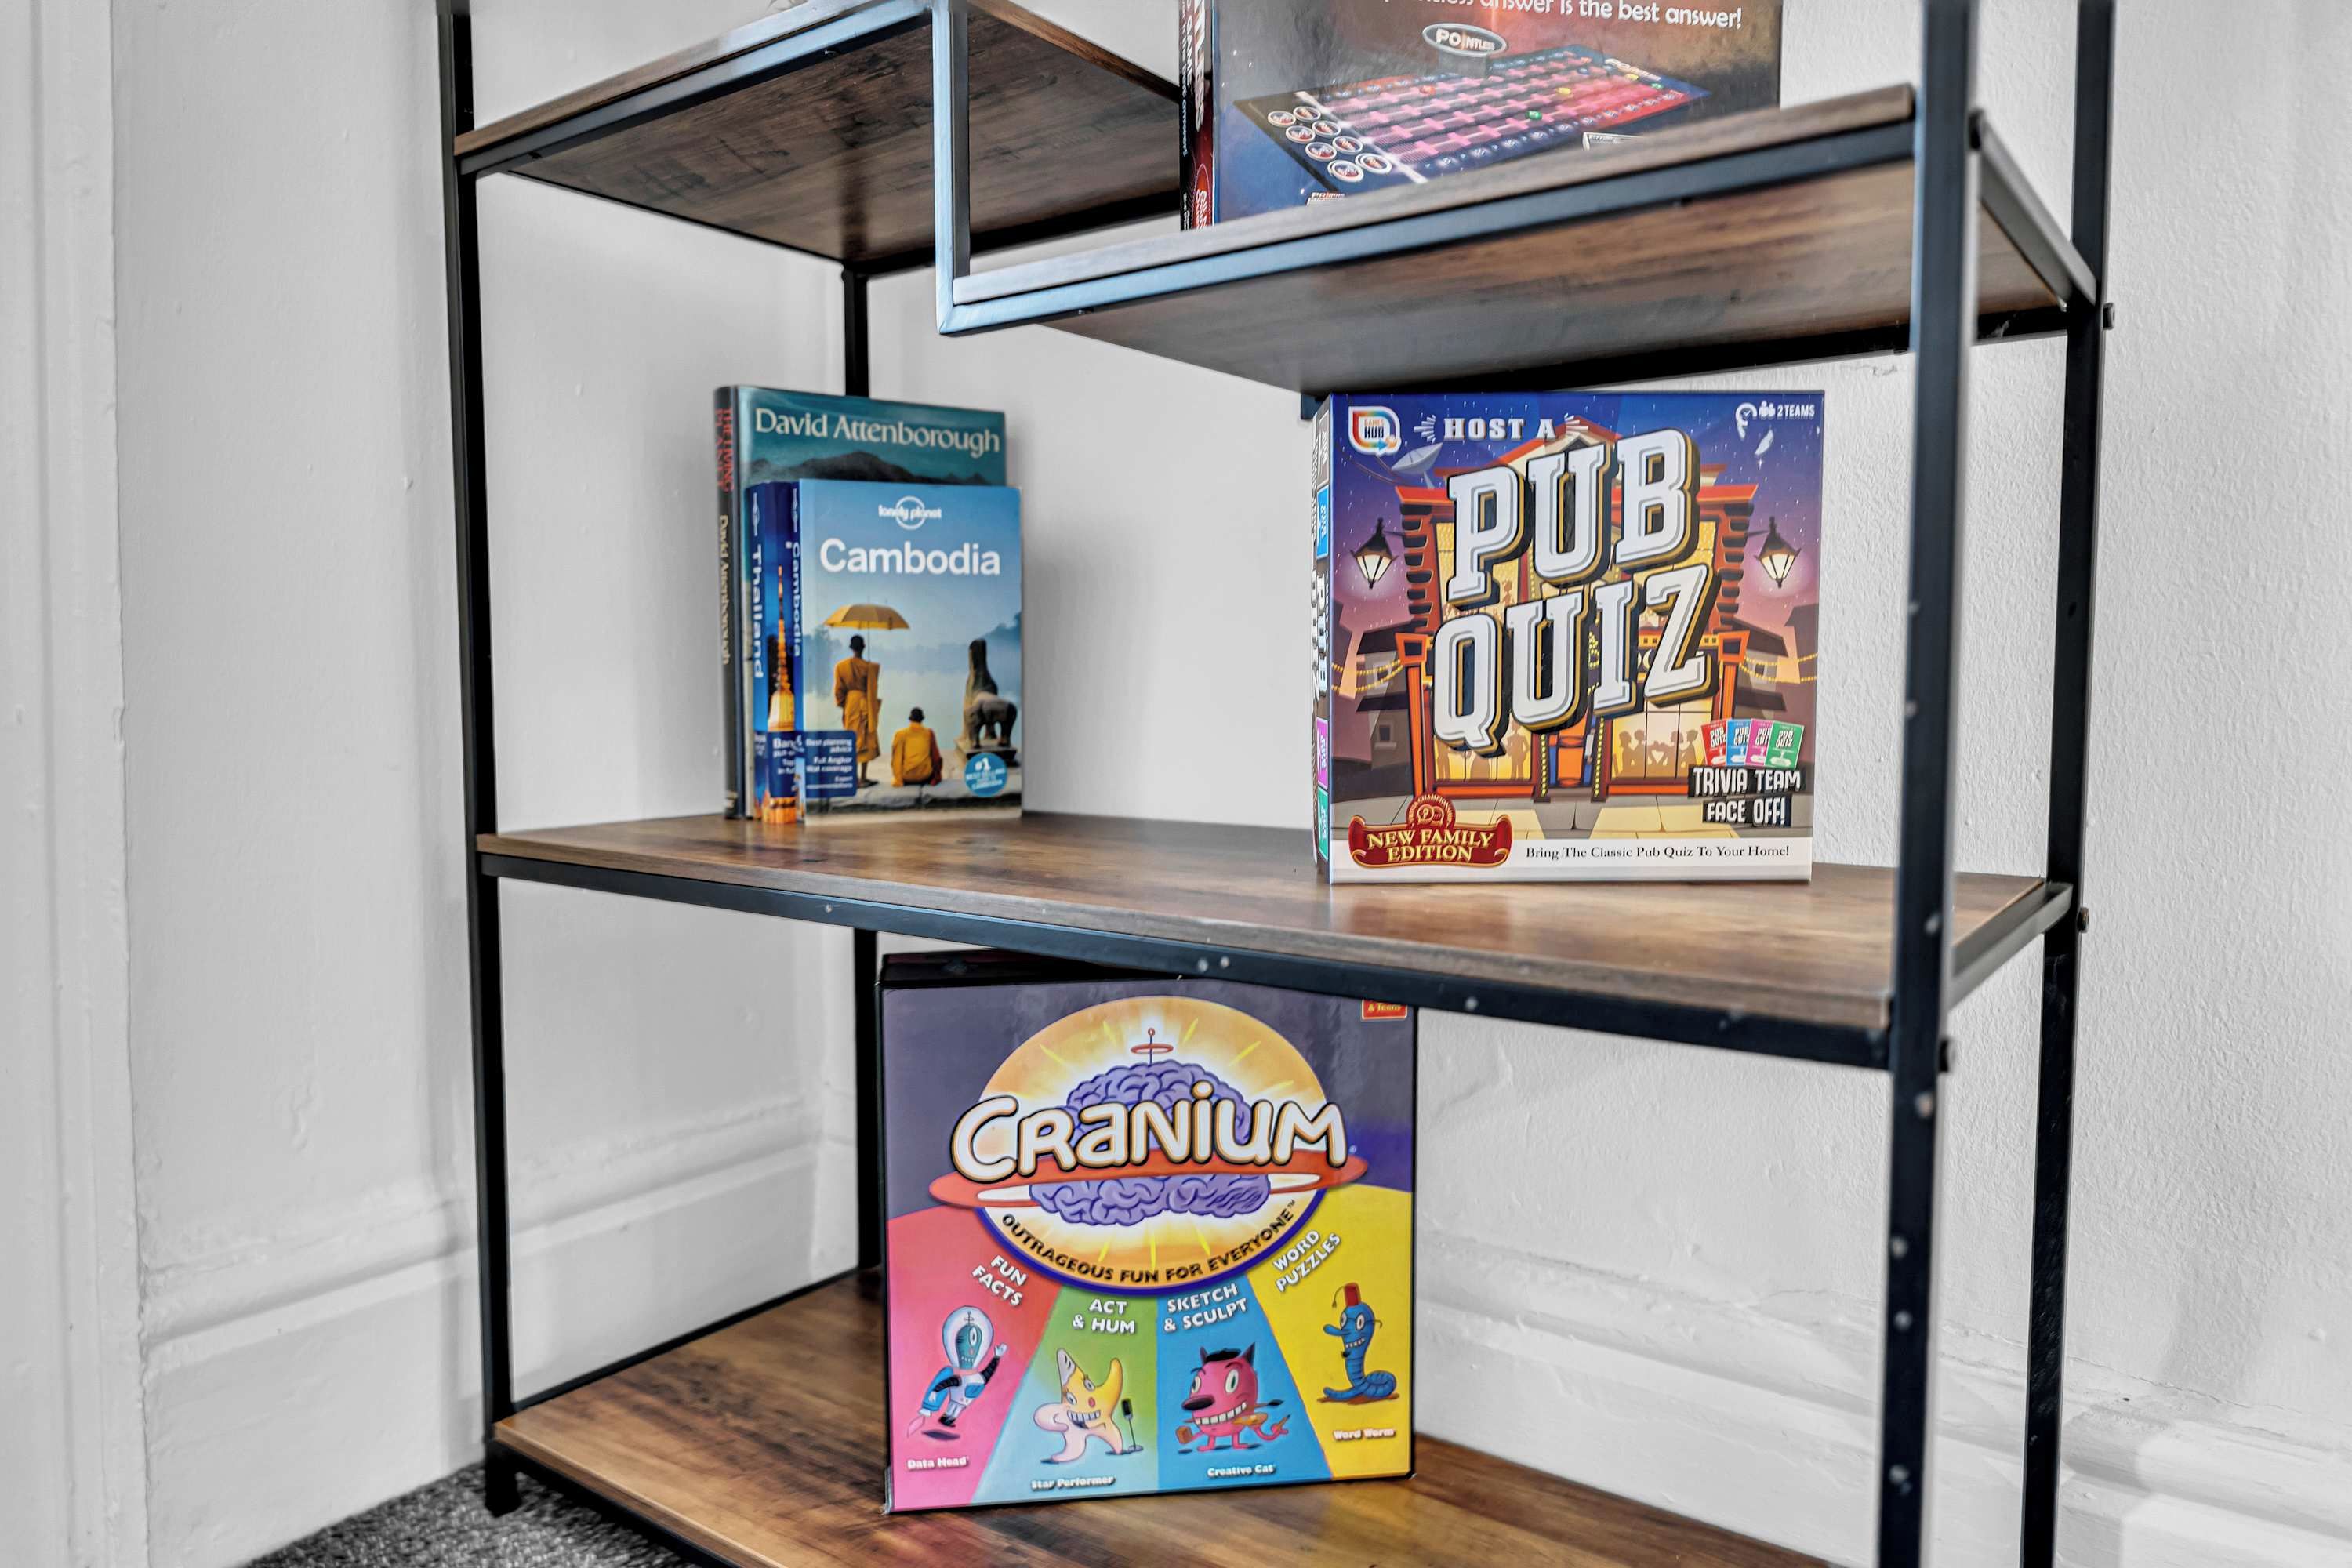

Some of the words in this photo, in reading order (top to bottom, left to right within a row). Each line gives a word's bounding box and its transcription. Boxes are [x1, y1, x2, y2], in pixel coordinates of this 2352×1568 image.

[1579, 0, 1613, 19] the
[1617, 0, 1661, 23] best
[1665, 7, 1742, 30] answer!
[1784, 405, 1815, 417] TEAMS
[755, 407, 828, 437] David
[833, 415, 1000, 458] Attenborough
[1365, 426, 1384, 439] HUB
[1443, 417, 1524, 441] HOST
[1536, 418, 1557, 440] A
[1448, 429, 1697, 607] PUB
[820, 538, 1000, 575] Cambodia
[753, 544, 764, 678] Thailand
[792, 542, 802, 657] Cambodia
[1434, 564, 1717, 754] QUIZ
[1693, 768, 1748, 796] TRIVIA
[1755, 769, 1801, 793] TEAM
[1707, 800, 1746, 822] FACE
[1753, 797, 1786, 825] OFF!
[1367, 830, 1415, 850] NEW
[1421, 829, 1494, 848] FAMILY
[1387, 844, 1473, 862] EDITION
[1526, 847, 1559, 860] Bring
[1563, 847, 1587, 858] The
[1591, 846, 1632, 858] Classic
[1635, 846, 1661, 857] Pub
[1664, 846, 1693, 858] Quiz
[1696, 846, 1713, 857] To
[1715, 846, 1744, 857] Your
[1748, 845, 1789, 857] Home!
[1002, 1214, 1114, 1281] OUTRAGEOUS
[1120, 1269, 1159, 1283] FUN
[1166, 1263, 1204, 1281] FOR
[1273, 1230, 1320, 1272] WORD
[1276, 1232, 1341, 1292] PUZZLES
[991, 1255, 1028, 1287] FUN
[972, 1265, 1022, 1306] FACTS
[1167, 1283, 1239, 1312] SKETCH
[1089, 1298, 1127, 1315] ACT
[1163, 1318, 1176, 1333] &
[1182, 1298, 1247, 1329] SCULPT
[1073, 1314, 1084, 1329] &
[1091, 1318, 1135, 1334] HUM
[1334, 1429, 1362, 1440] Word
[1364, 1428, 1394, 1438] Worm
[907, 1458, 935, 1470] Data
[938, 1457, 967, 1468] Head
[1207, 1465, 1252, 1478] Creative
[1254, 1464, 1274, 1473] Cat
[1031, 1479, 1055, 1490] Star
[1058, 1475, 1115, 1489] Performer
